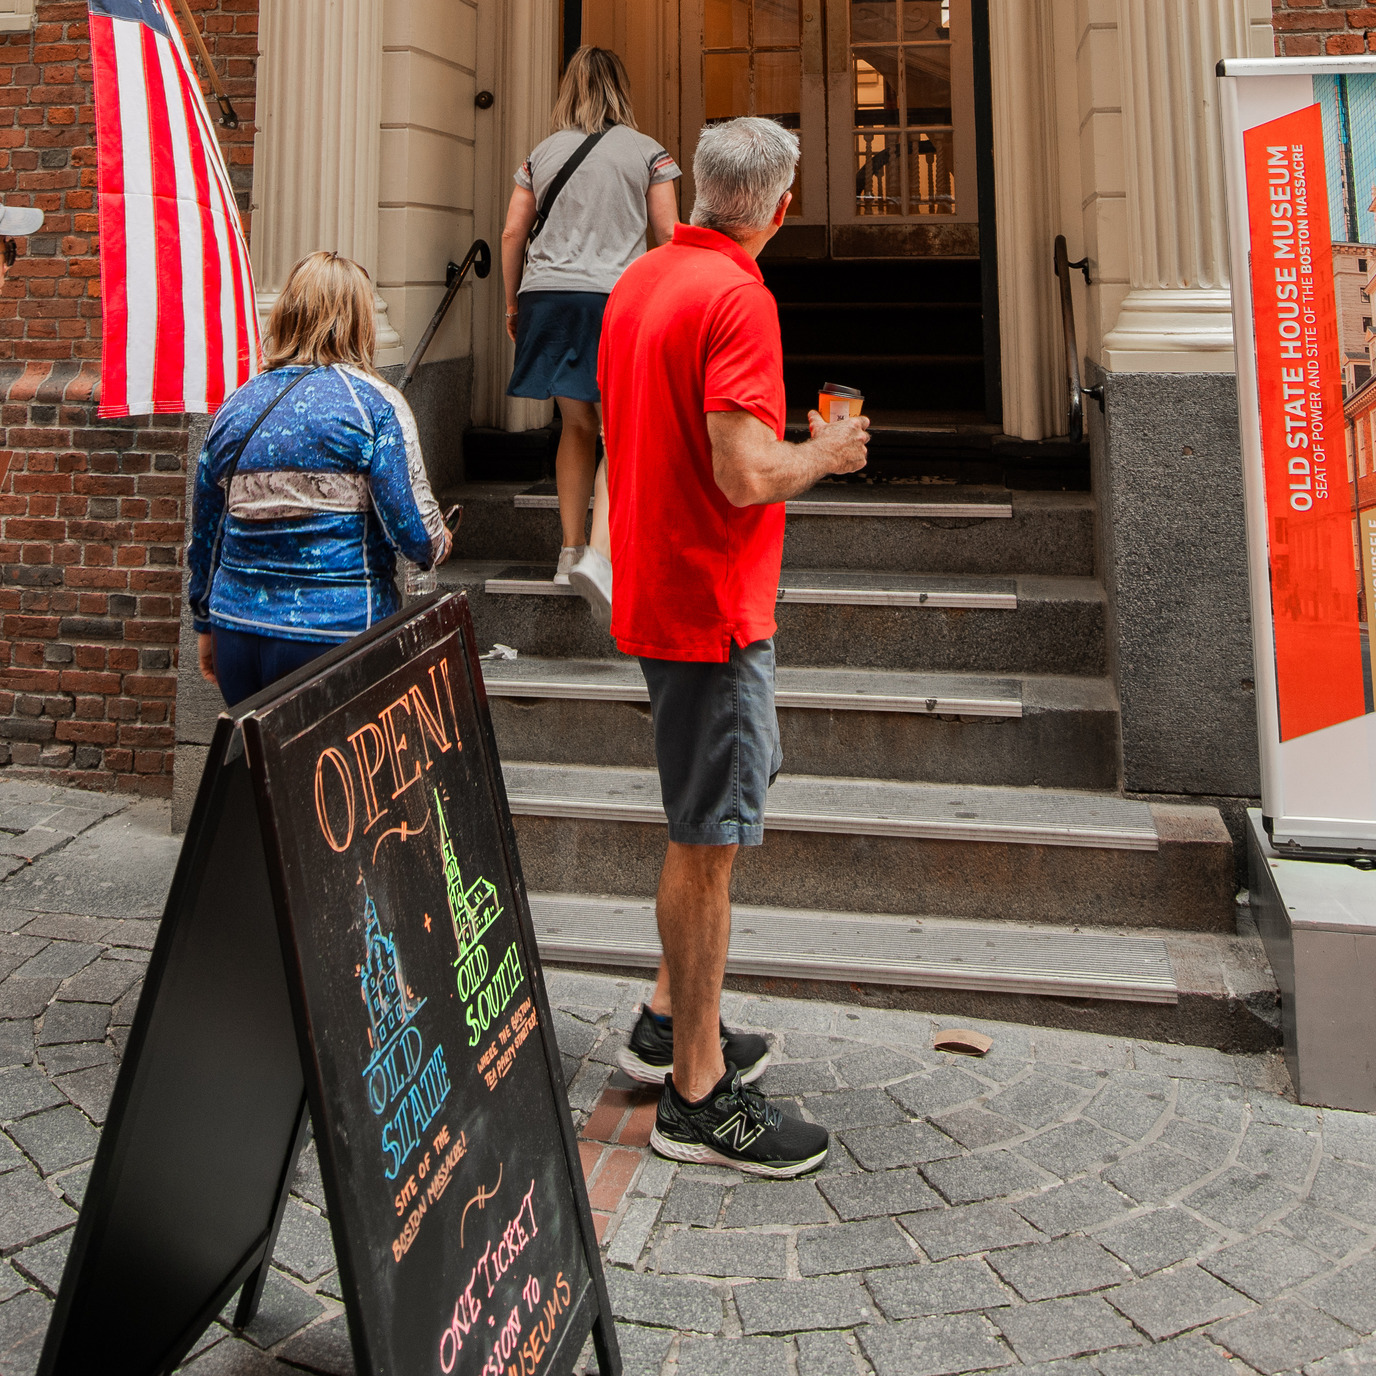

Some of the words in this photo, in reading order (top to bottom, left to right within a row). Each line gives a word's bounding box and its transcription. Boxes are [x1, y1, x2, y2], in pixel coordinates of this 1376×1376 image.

[1266, 146, 1295, 259] MUSEUM
[1292, 144, 1308, 216] MASSACRE
[1297, 220, 1312, 274] BOSTON
[1275, 267, 1302, 359] HOUSE
[1301, 277, 1313, 303] THE
[1304, 306, 1316, 324] OF
[1305, 327, 1319, 357] SITE
[1307, 360, 1320, 389] AND
[1282, 367, 1308, 449] STATE
[1310, 392, 1324, 441] POWER
[1288, 456, 1313, 512] OLD
[1313, 448, 1325, 462] OF
[1315, 466, 1328, 499] SEAT
[314, 656, 464, 853] OPEN!
[456, 944, 492, 1002] OLD
[464, 942, 524, 1046] SOUTH
[476, 1041, 499, 1074] WHERE
[498, 1024, 512, 1046] THE
[510, 996, 532, 1030] BOSTON
[368, 1026, 423, 1114] OLD
[484, 1066, 498, 1087] TEA
[496, 1043, 516, 1078] PARTY
[382, 1044, 452, 1180] STATE
[713, 1110, 765, 1152] N
[392, 1195, 427, 1263] BOSTON
[427, 1130, 467, 1205] MASSACRE!
[395, 1174, 418, 1217] SITE
[418, 1152, 431, 1179] OF
[433, 1124, 450, 1155] THE
[439, 1267, 482, 1374] ONE
[478, 1178, 538, 1298] TICKET
[523, 1274, 541, 1313] TO
